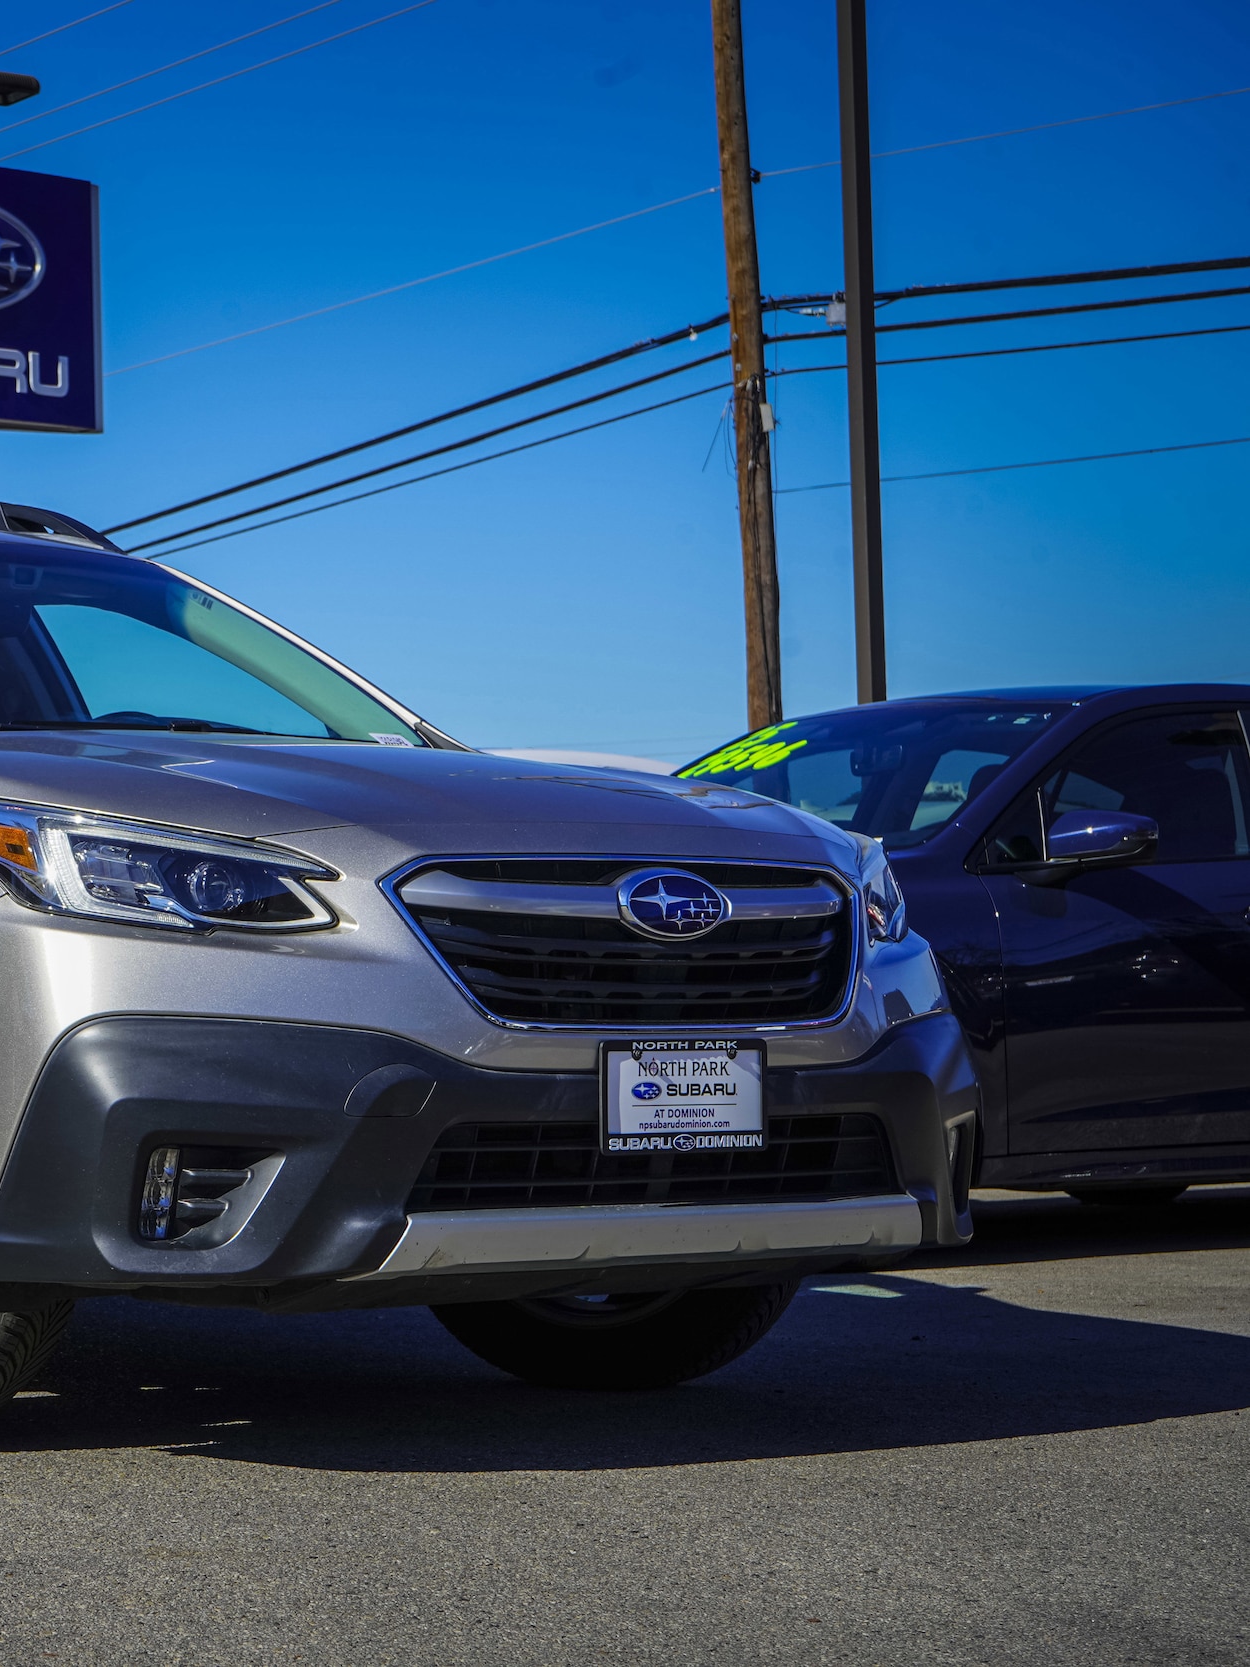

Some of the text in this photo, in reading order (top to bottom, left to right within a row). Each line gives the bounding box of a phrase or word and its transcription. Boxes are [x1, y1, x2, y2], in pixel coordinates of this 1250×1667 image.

[632, 1040, 738, 1050] NORTH PARK
[638, 1060, 730, 1077] NORTH PARK
[654, 1108, 715, 1119] AT DOMINION
[639, 1119, 730, 1131] npsubarudominion.com
[696, 1134, 762, 1148] DOMINION
